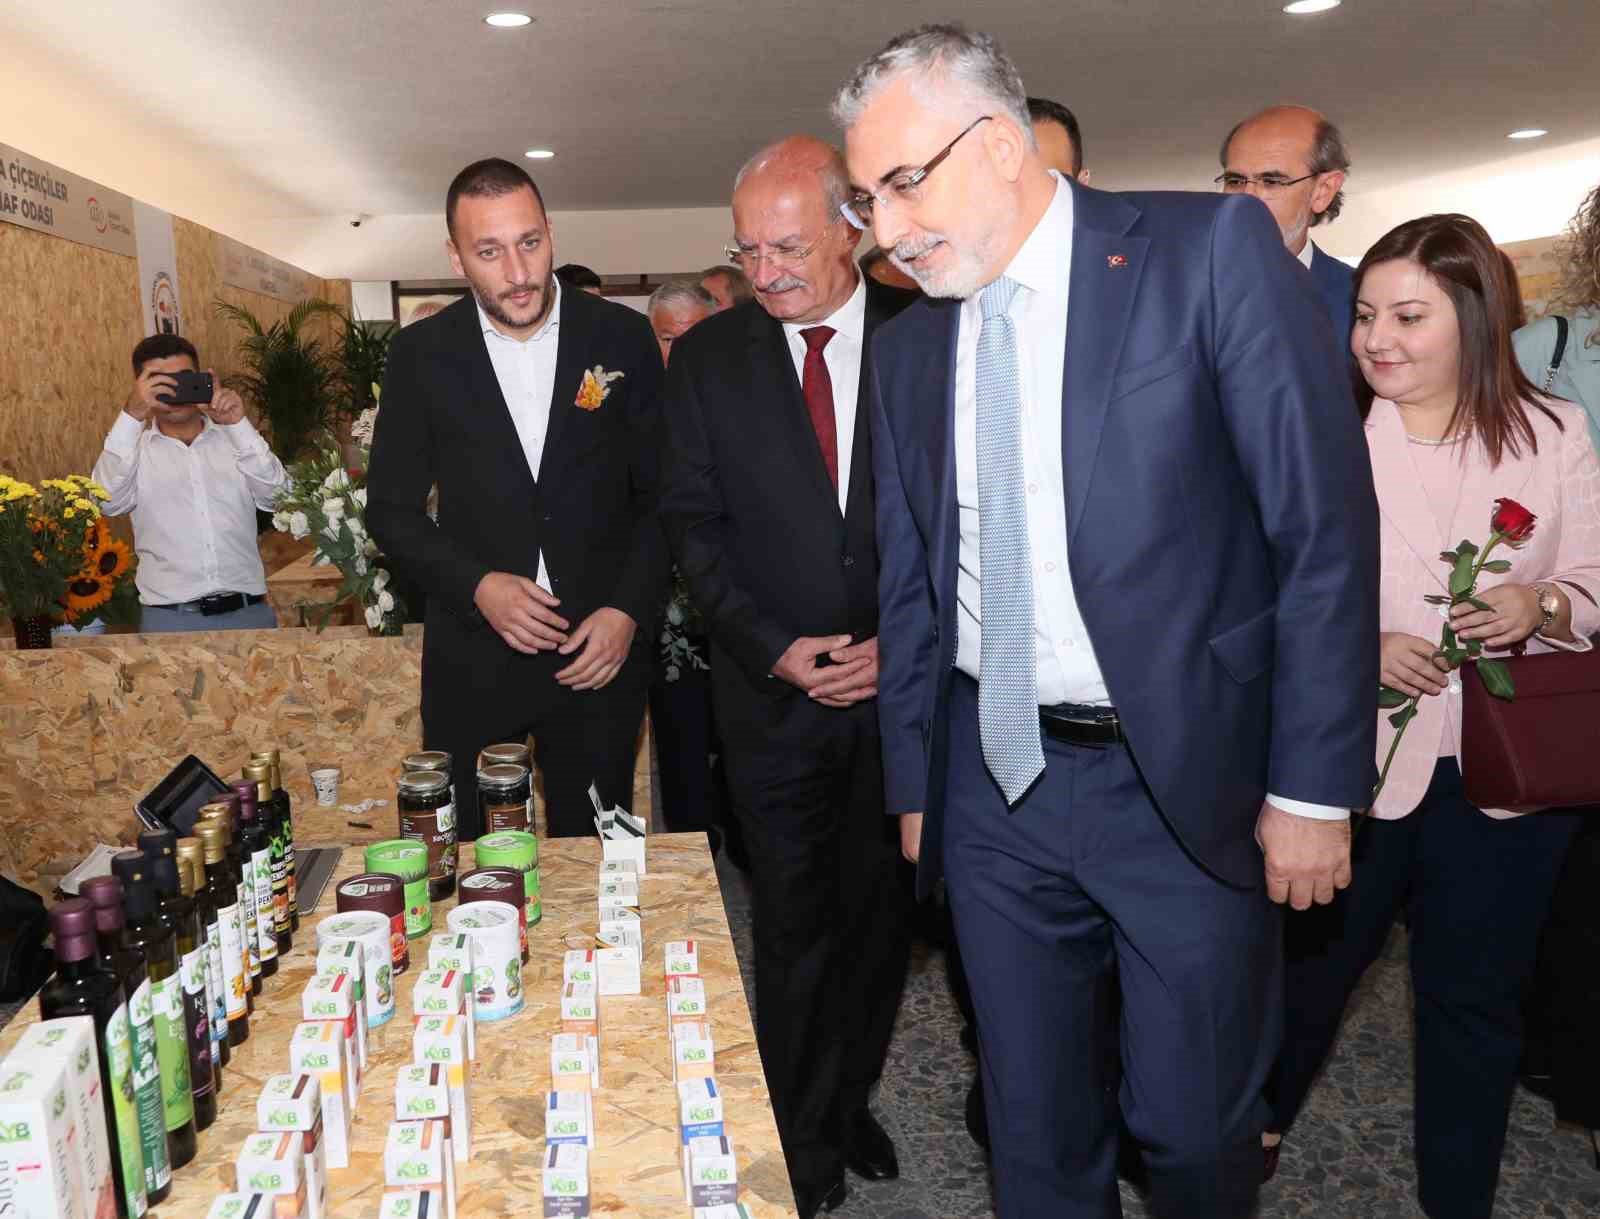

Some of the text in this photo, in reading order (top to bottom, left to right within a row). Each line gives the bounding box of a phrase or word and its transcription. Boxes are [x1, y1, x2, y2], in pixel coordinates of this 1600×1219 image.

[9, 159, 69, 203] ÇİÇEKÇİLER
[21, 198, 54, 226] ODASI
[0, 1119, 31, 1142] YB
